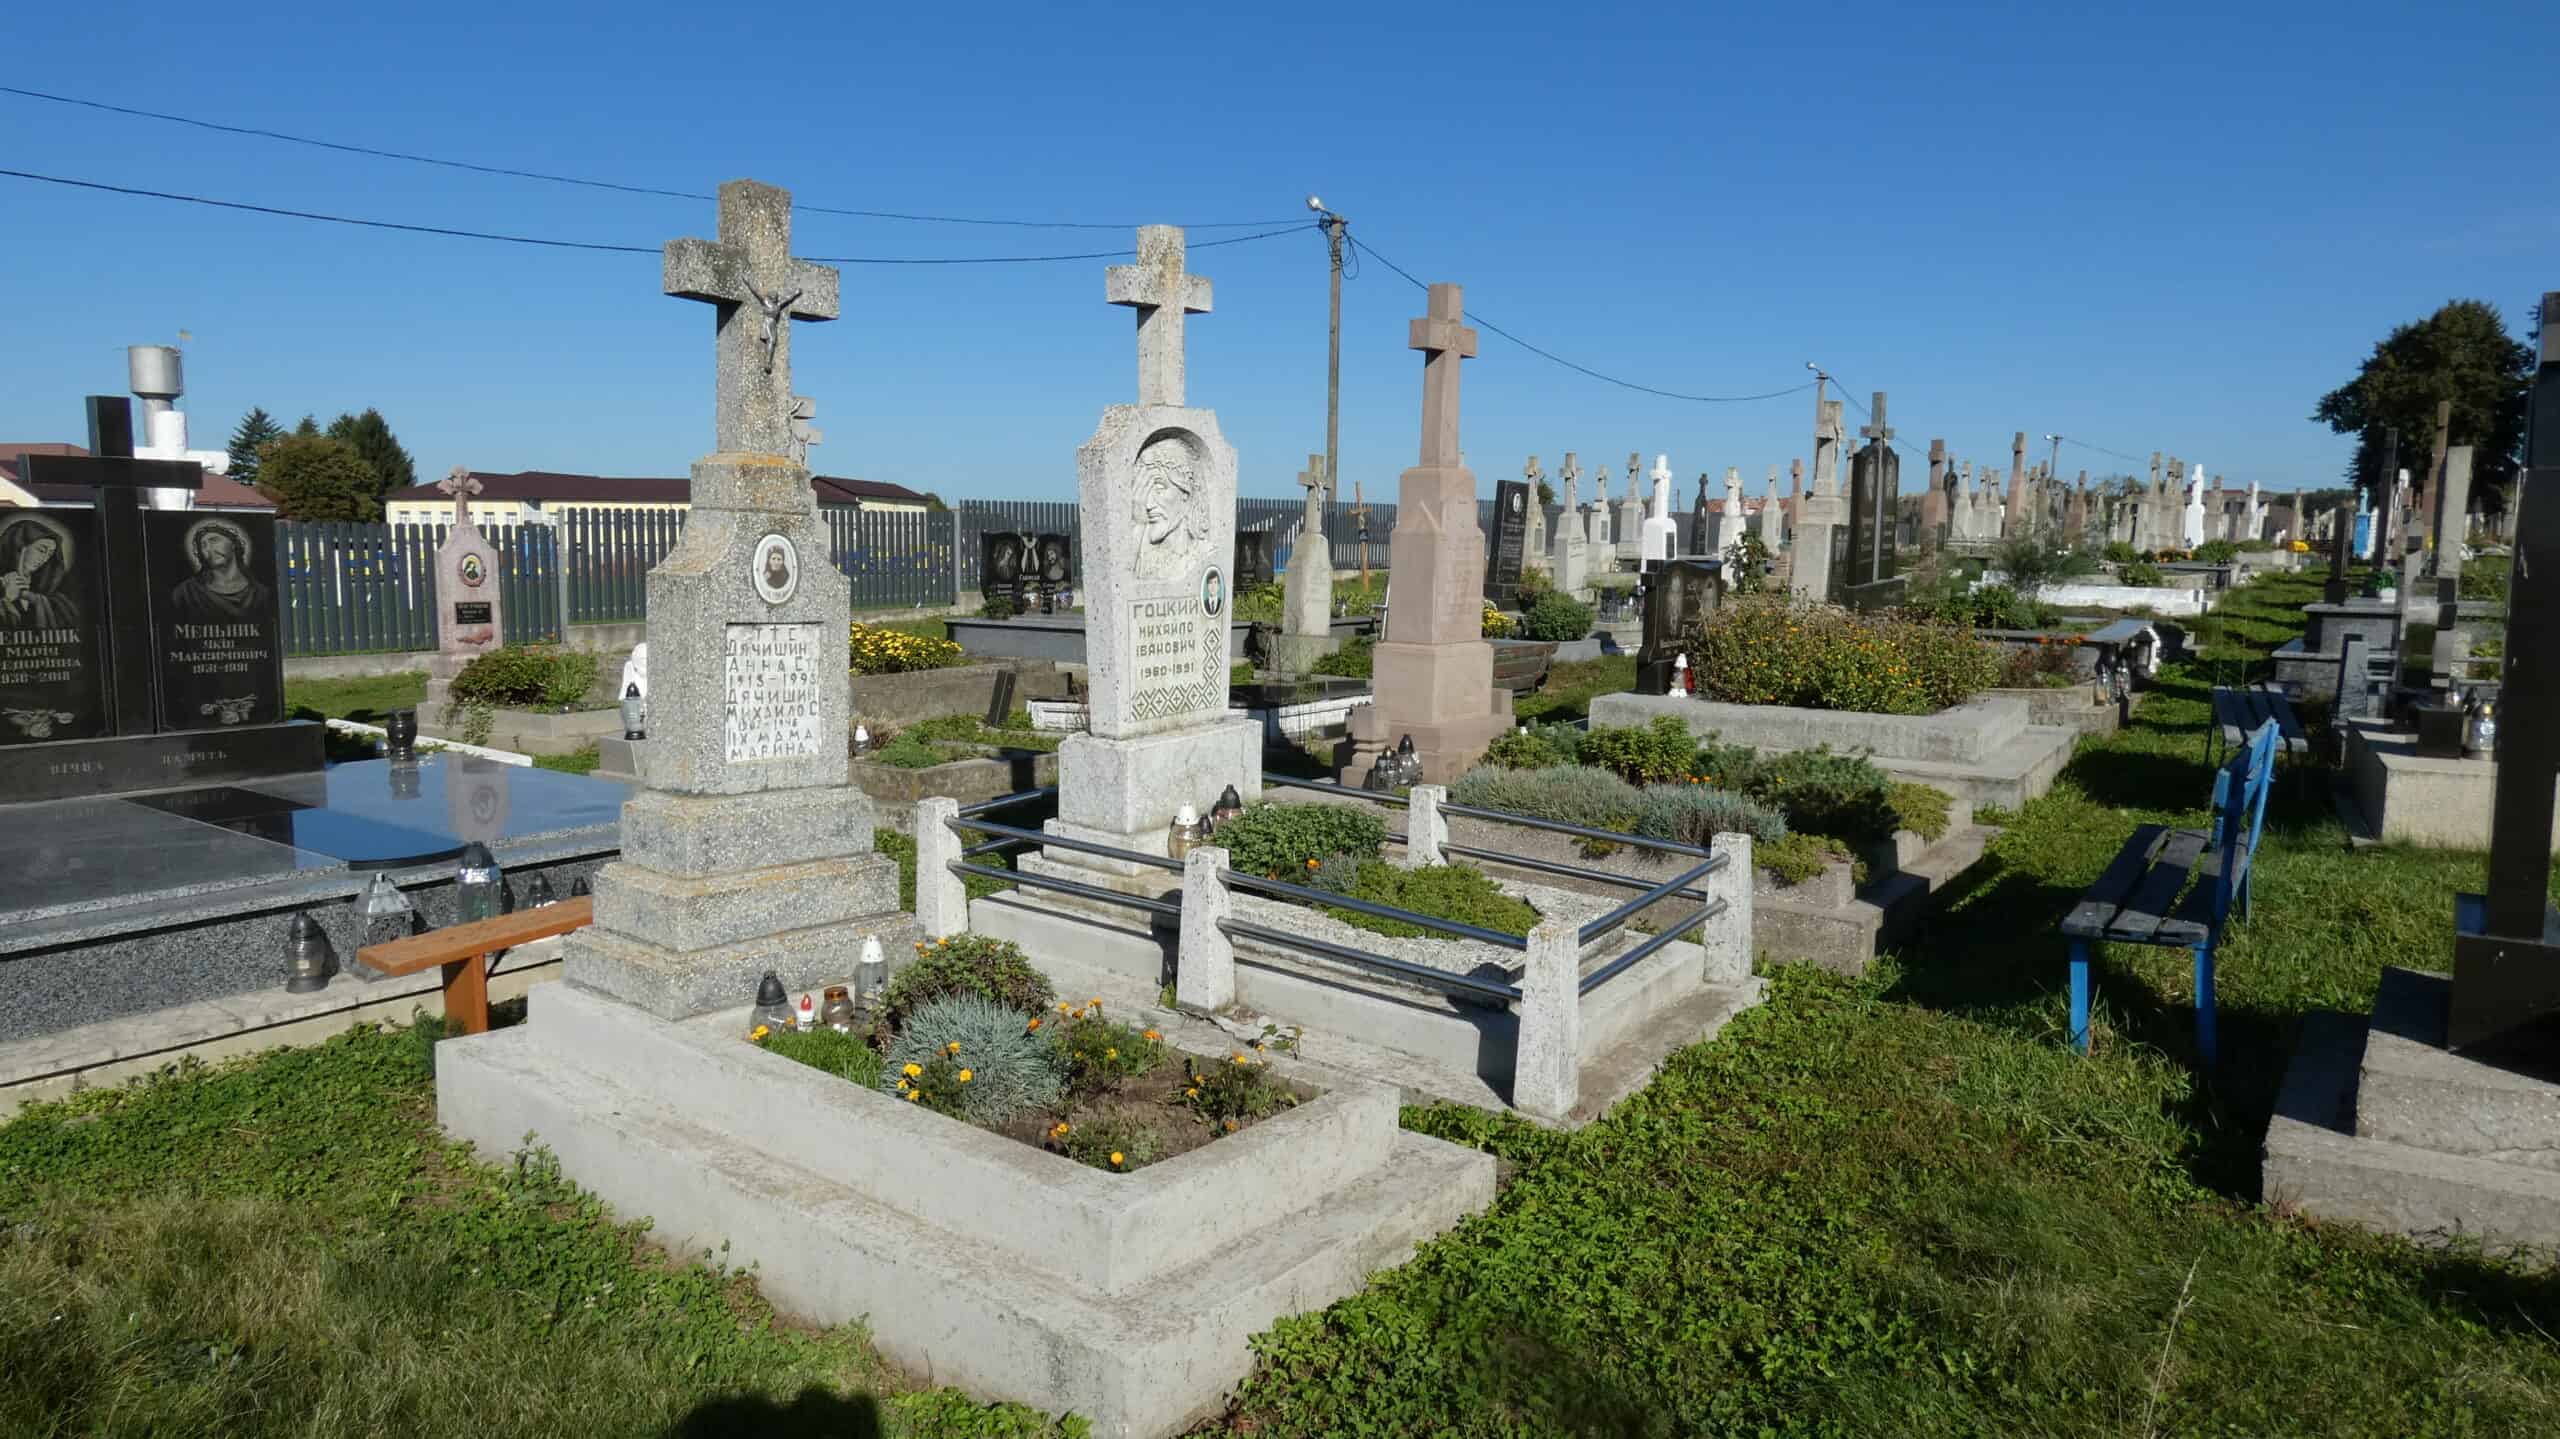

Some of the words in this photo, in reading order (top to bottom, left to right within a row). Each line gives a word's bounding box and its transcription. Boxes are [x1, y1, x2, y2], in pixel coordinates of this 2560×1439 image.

[0, 628, 81, 646] ЕЛЬНИК
[175, 623, 260, 639] МЕЛЬНИК
[725, 640, 807, 657] ДЯЧИШИН
[1136, 639, 1196, 657] ІВАНОВИЧ
[0, 656, 81, 671] ЕДОРІВНА
[729, 657, 786, 673] АННА
[726, 687, 817, 705] ДЯЧИШИН
